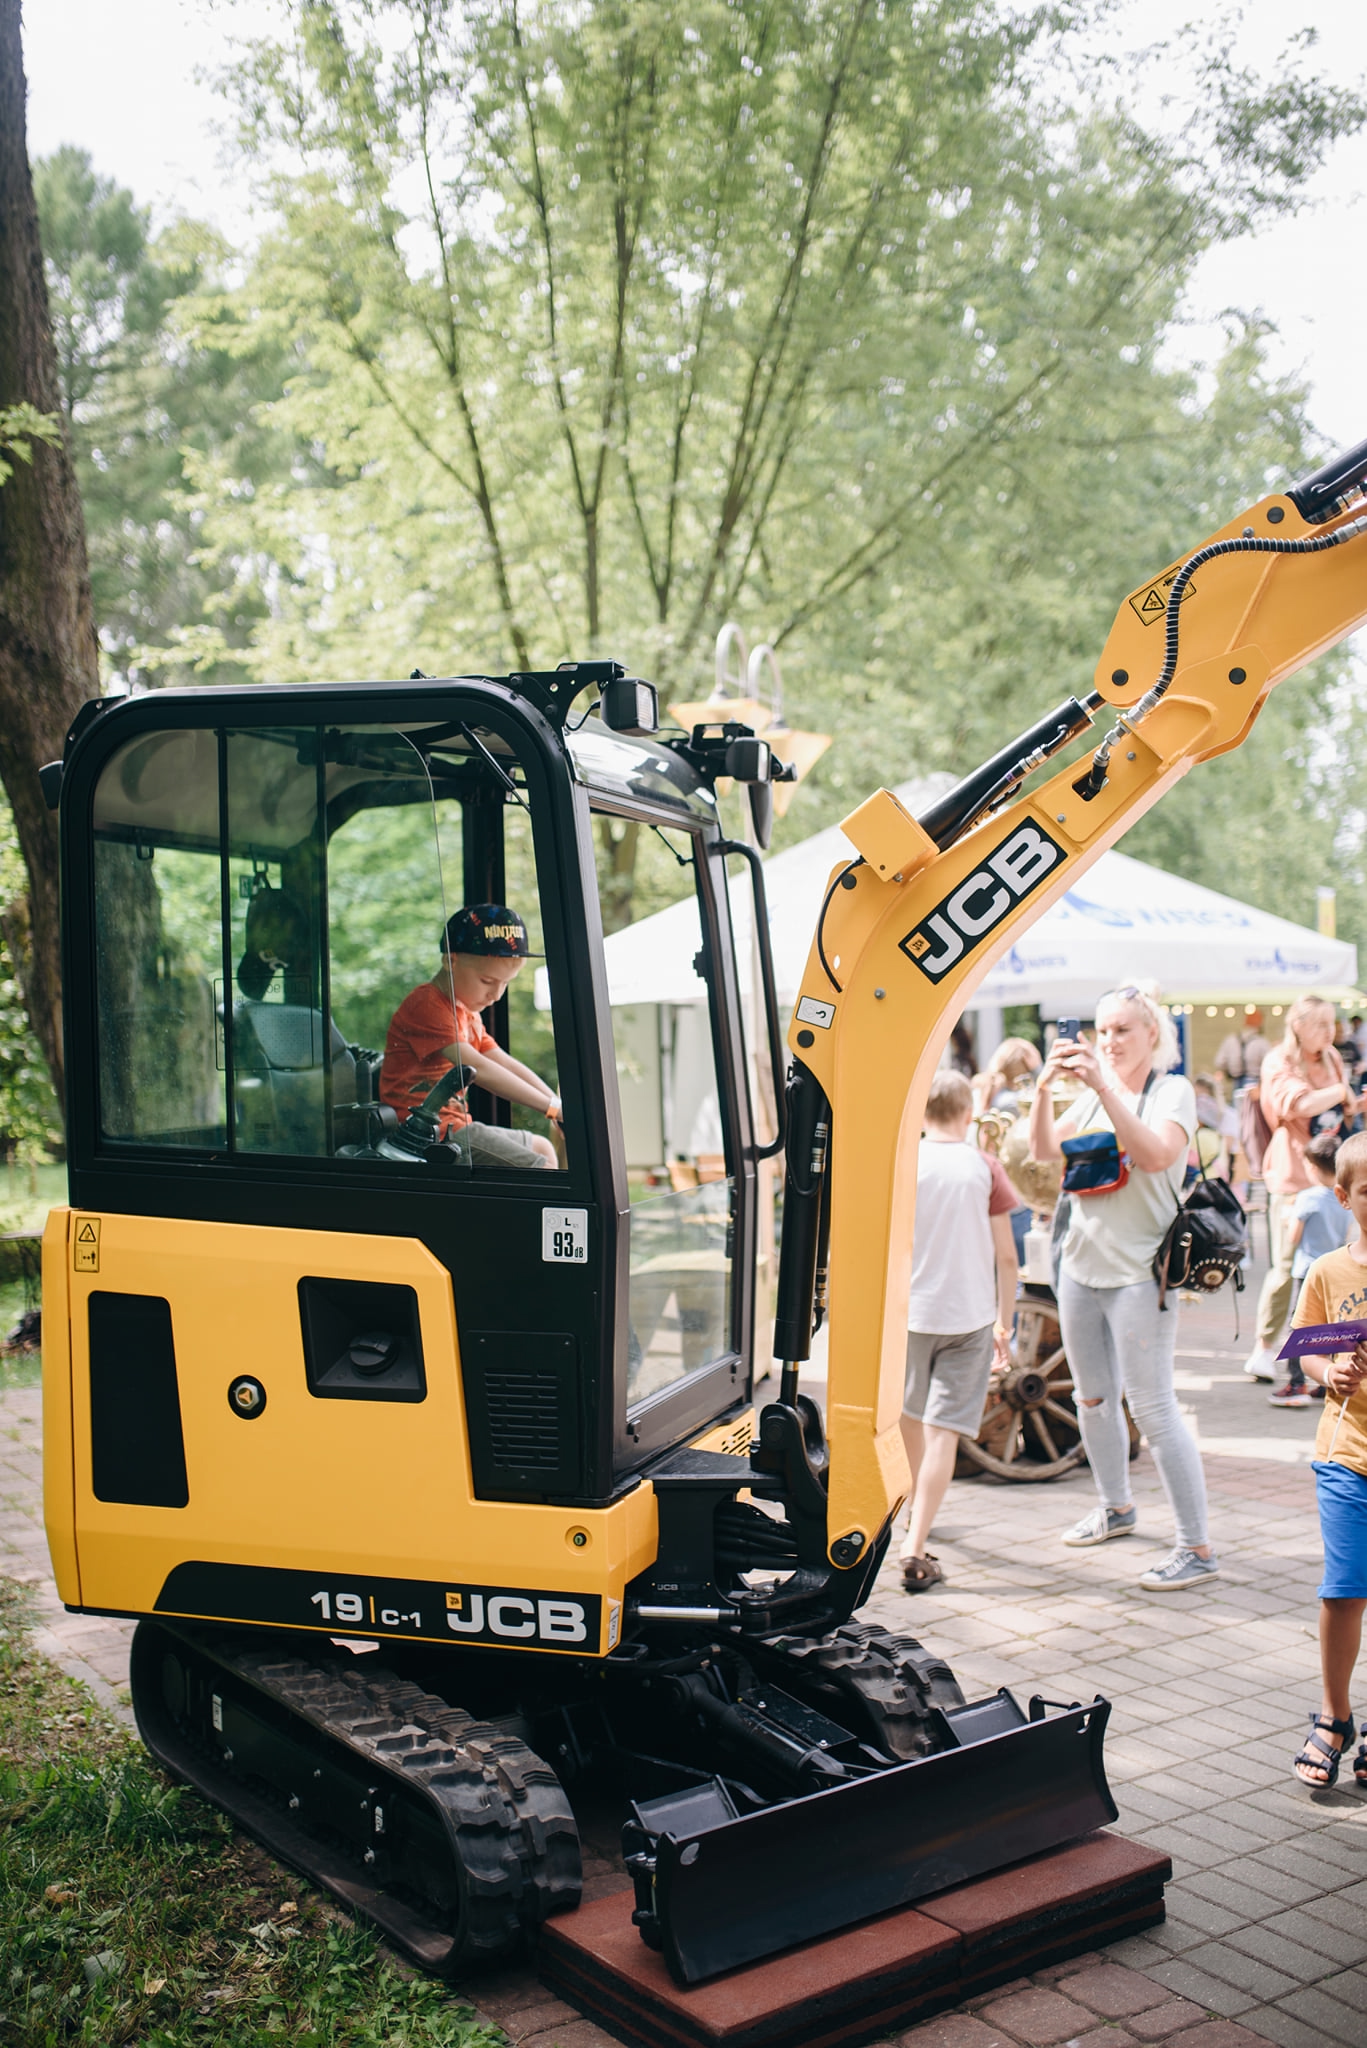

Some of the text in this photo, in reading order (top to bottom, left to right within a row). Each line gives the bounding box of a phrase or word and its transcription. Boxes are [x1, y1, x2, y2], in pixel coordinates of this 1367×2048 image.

[922, 827, 1058, 975] JCB
[565, 1217, 571, 1226] L
[554, 1232, 574, 1258] 93
[1308, 1332, 1361, 1344] ЖУРНАЛИСТ
[310, 1591, 364, 1622] 19
[446, 1593, 587, 1643] JCB
